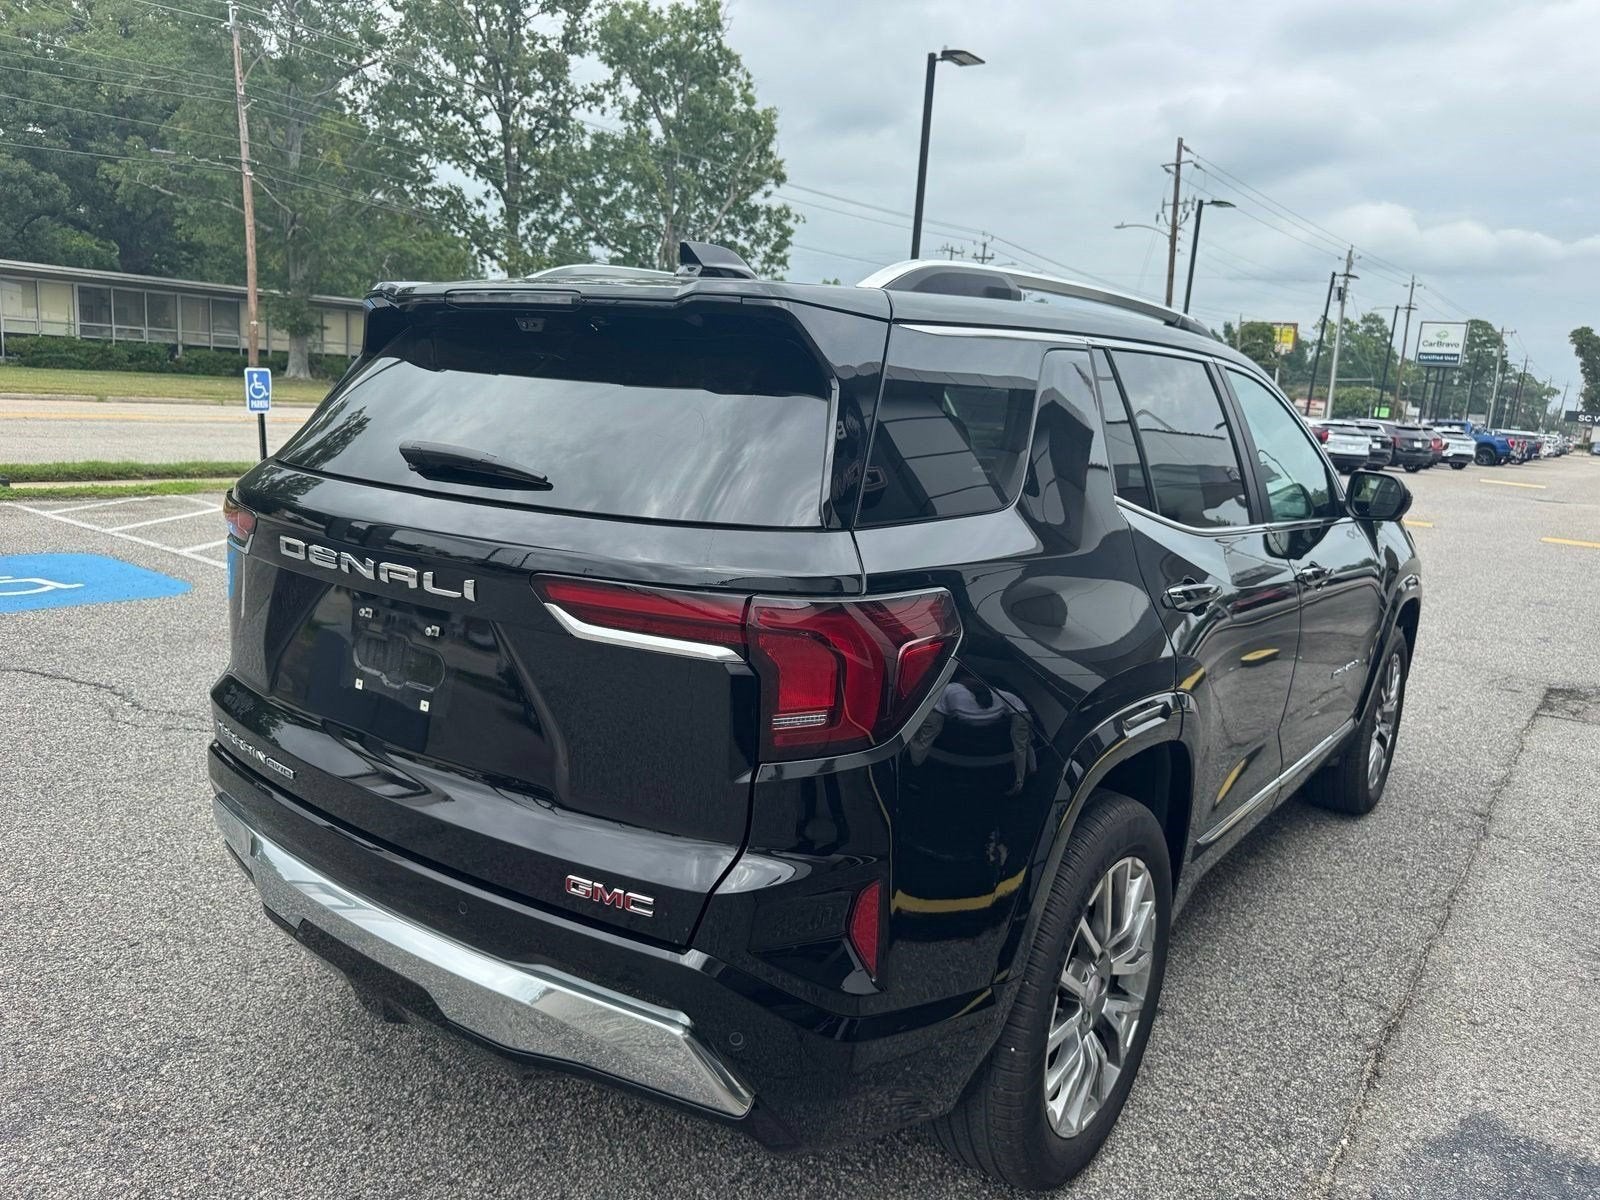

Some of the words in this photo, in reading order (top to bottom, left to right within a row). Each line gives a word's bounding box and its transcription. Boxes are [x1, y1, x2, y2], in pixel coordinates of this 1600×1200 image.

[1422, 340, 1460, 349] CarBravo
[1419, 353, 1444, 361] Certified
[1577, 414, 1592, 422] SC
[279, 535, 475, 602] DENALI
[565, 874, 654, 917] GMC
